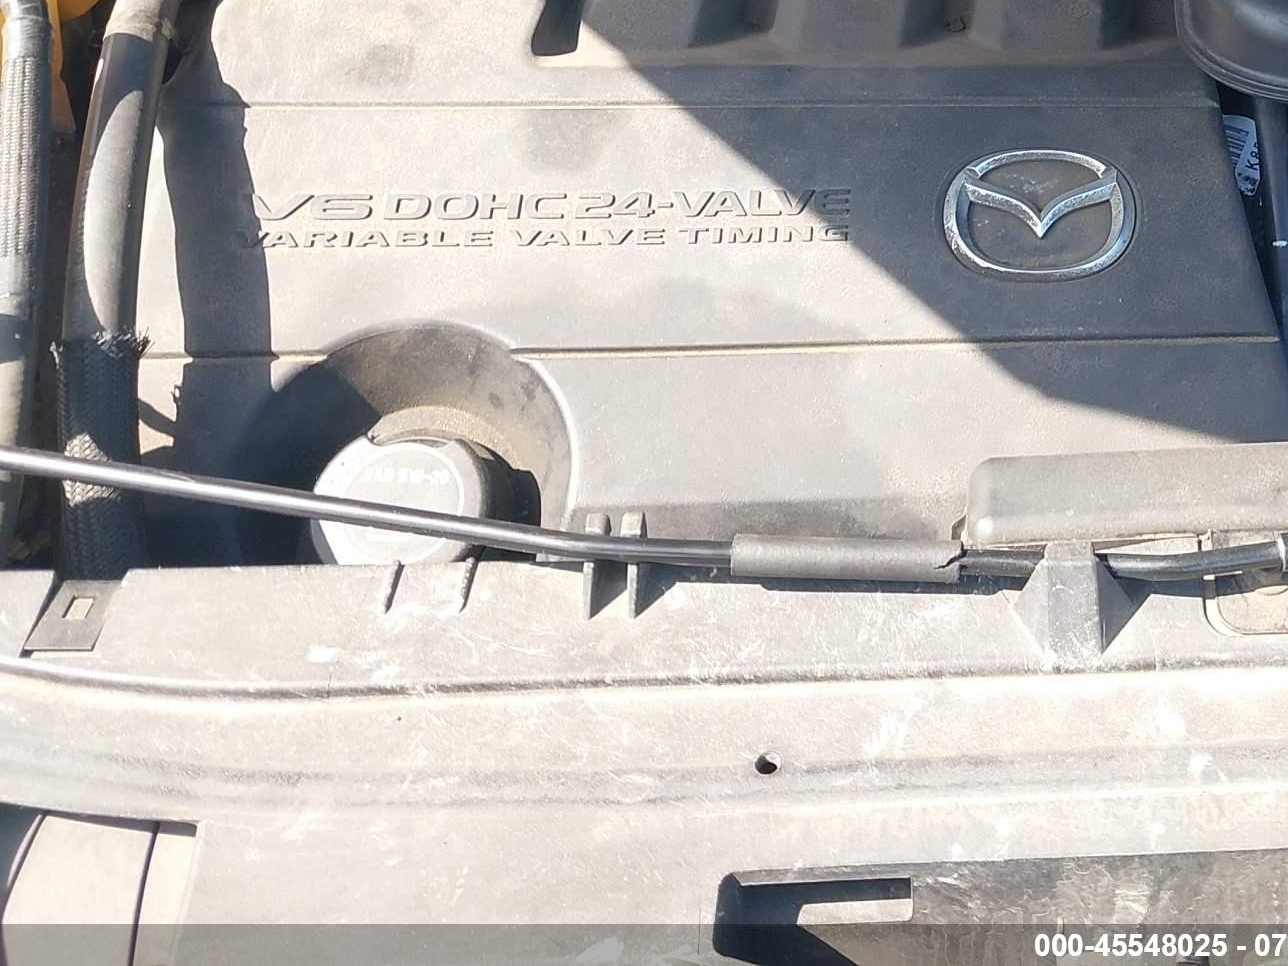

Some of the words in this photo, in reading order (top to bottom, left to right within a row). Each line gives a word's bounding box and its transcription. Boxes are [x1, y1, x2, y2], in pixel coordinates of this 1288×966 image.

[245, 193, 374, 221] V6
[383, 193, 567, 221] DOHC
[574, 189, 852, 219] 24-VALVE
[237, 230, 494, 248] VARIABLE
[514, 228, 666, 247] VALVE
[678, 224, 850, 245] TIMING
